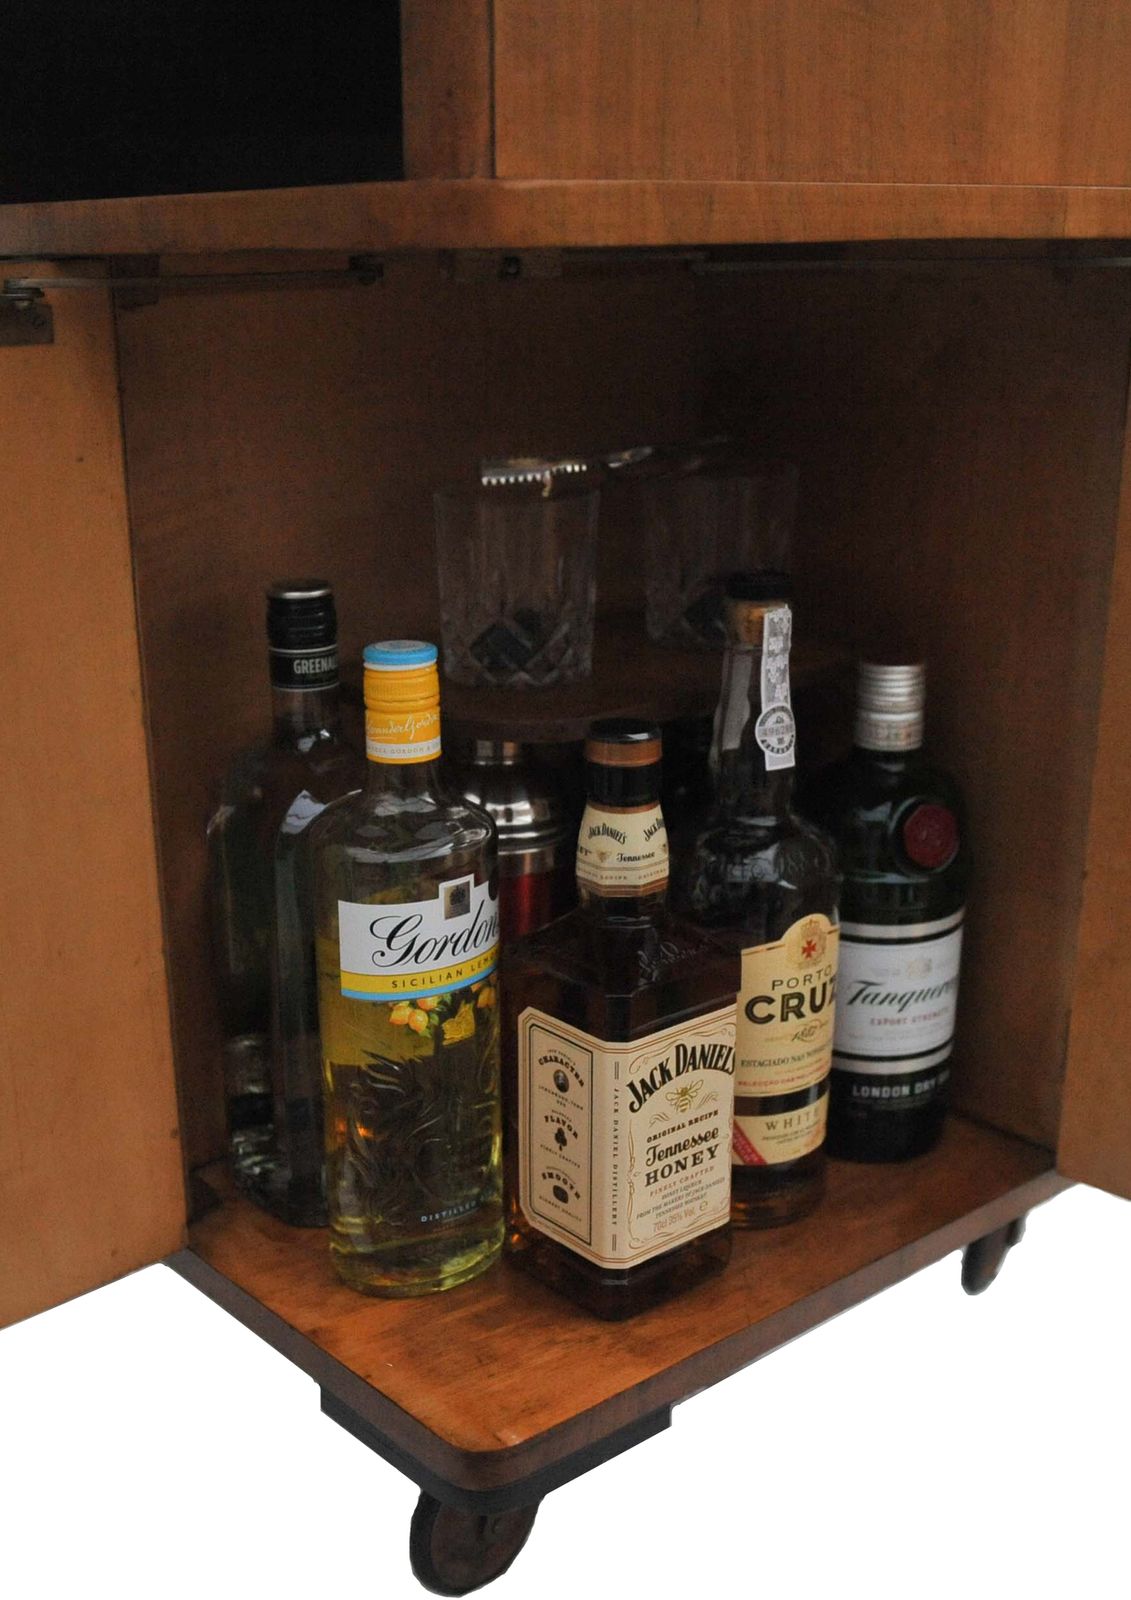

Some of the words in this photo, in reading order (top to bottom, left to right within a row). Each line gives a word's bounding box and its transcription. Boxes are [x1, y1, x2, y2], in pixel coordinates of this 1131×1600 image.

[616, 851, 656, 863] Tennessee
[392, 969, 464, 989] SICILIAN
[771, 964, 832, 991] PORTO
[538, 1055, 584, 1087] CHARACTER
[626, 1057, 673, 1113] JACK
[852, 1085, 910, 1098] LONDON
[914, 1078, 936, 1095] DRY
[544, 1115, 578, 1140] FLAVOR
[647, 1123, 686, 1143] ORIGINAL
[688, 1110, 719, 1126] RECIPE
[646, 1127, 719, 1167] Tennessee
[645, 1143, 720, 1187] HONEY
[541, 1172, 581, 1200] SMOOTH
[650, 1181, 677, 1198] FINELY
[679, 1166, 715, 1183] CRAFTED
[420, 1200, 477, 1222] DISTILLED
[636, 1209, 651, 1220] FROM
